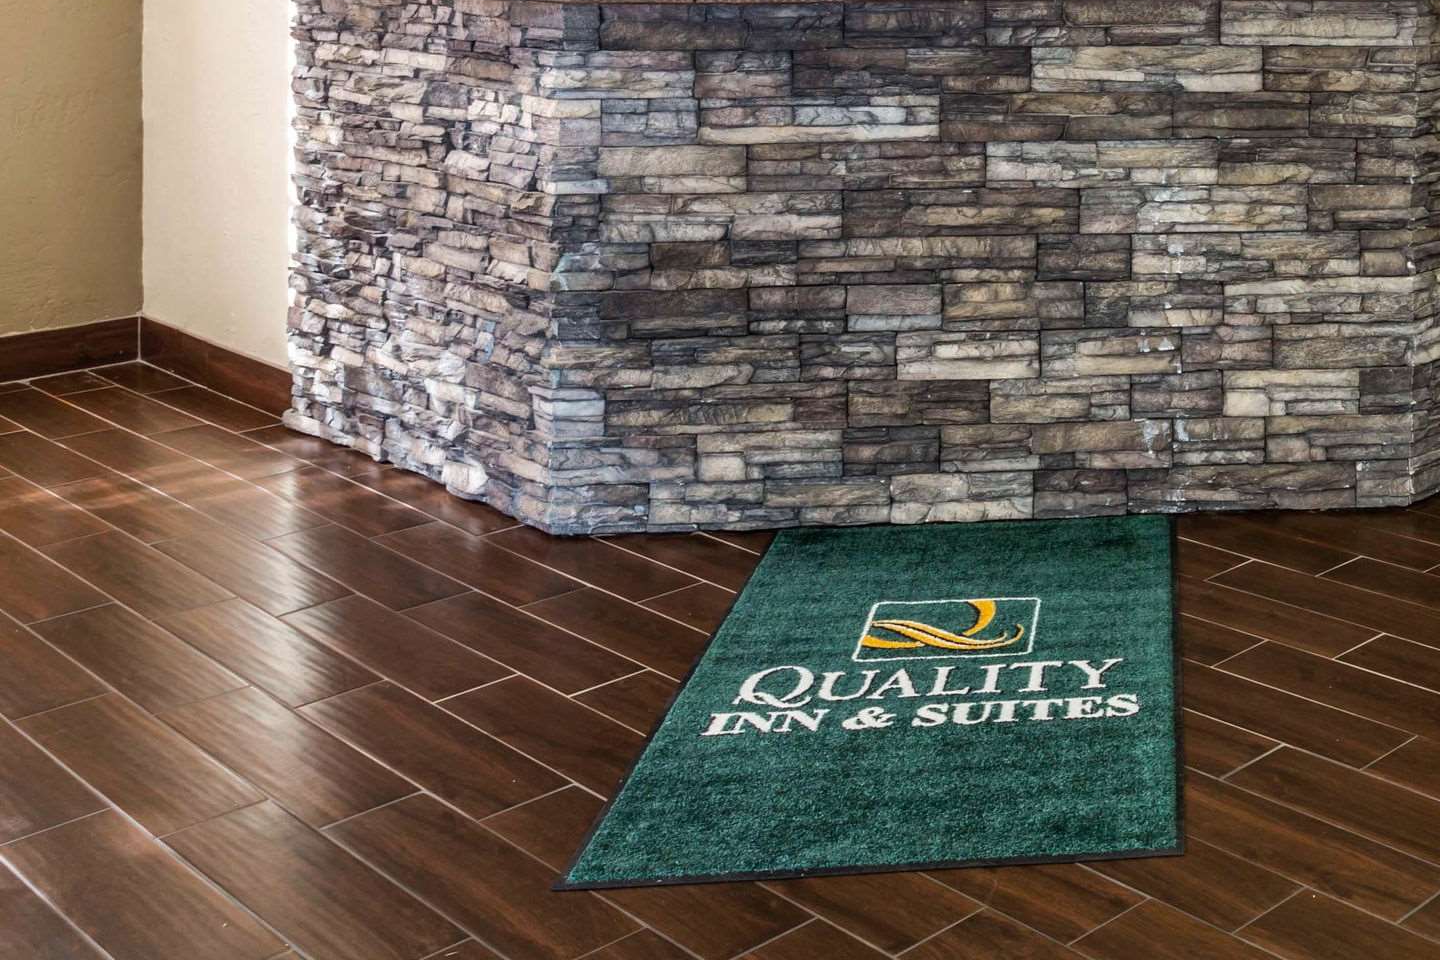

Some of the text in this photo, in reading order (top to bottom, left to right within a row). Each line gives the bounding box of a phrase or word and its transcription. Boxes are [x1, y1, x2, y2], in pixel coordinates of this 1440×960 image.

[732, 658, 1124, 709] QUALITY
[701, 693, 1141, 737] INN & SUITES
